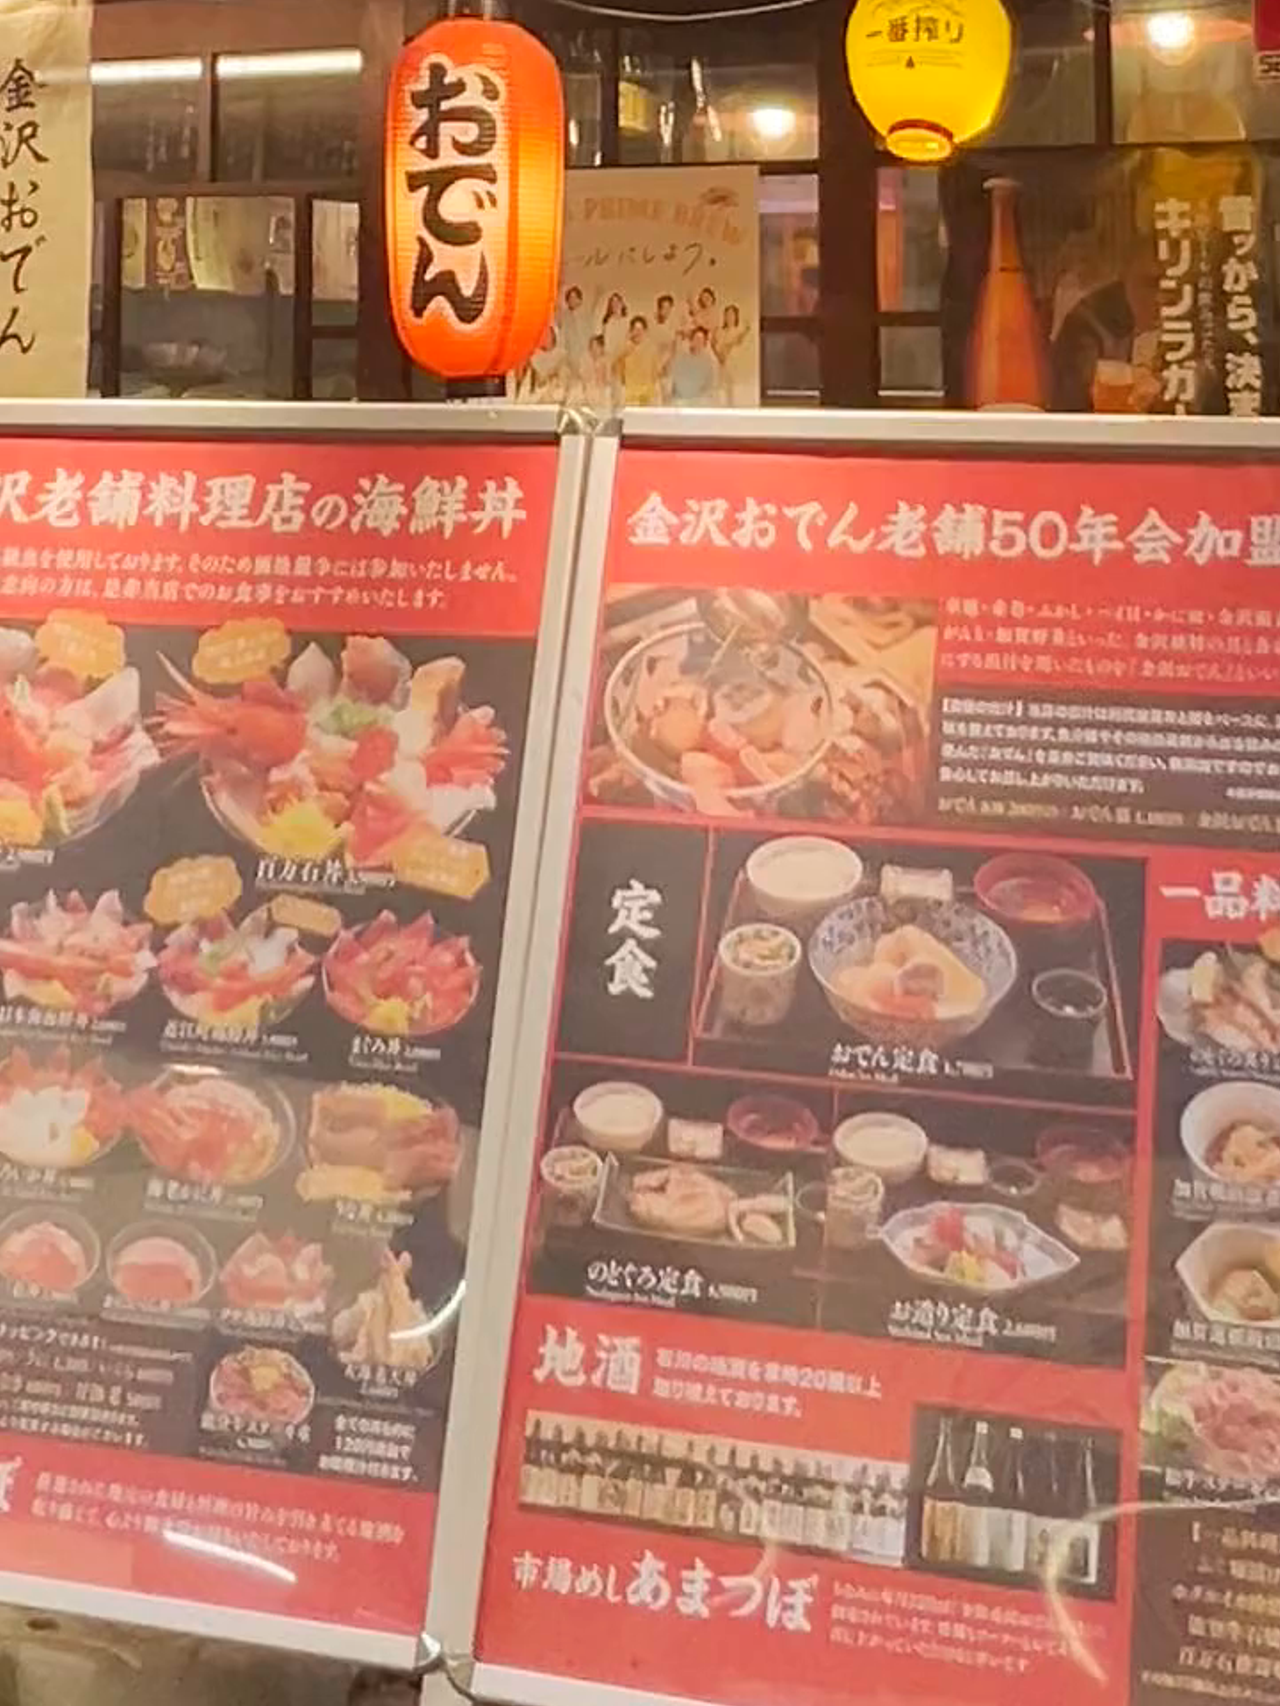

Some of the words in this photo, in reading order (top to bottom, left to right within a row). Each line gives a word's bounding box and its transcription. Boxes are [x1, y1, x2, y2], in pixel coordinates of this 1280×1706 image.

[866, 12, 965, 45] 一番搾り
[405, 60, 500, 324] おでん
[603, 879, 665, 1000] 定食
[831, 1042, 939, 1074] おでん定食
[588, 1259, 705, 1298] のどぐろ定食
[890, 1299, 999, 1336] お造り定食
[533, 1324, 643, 1395] 地酒
